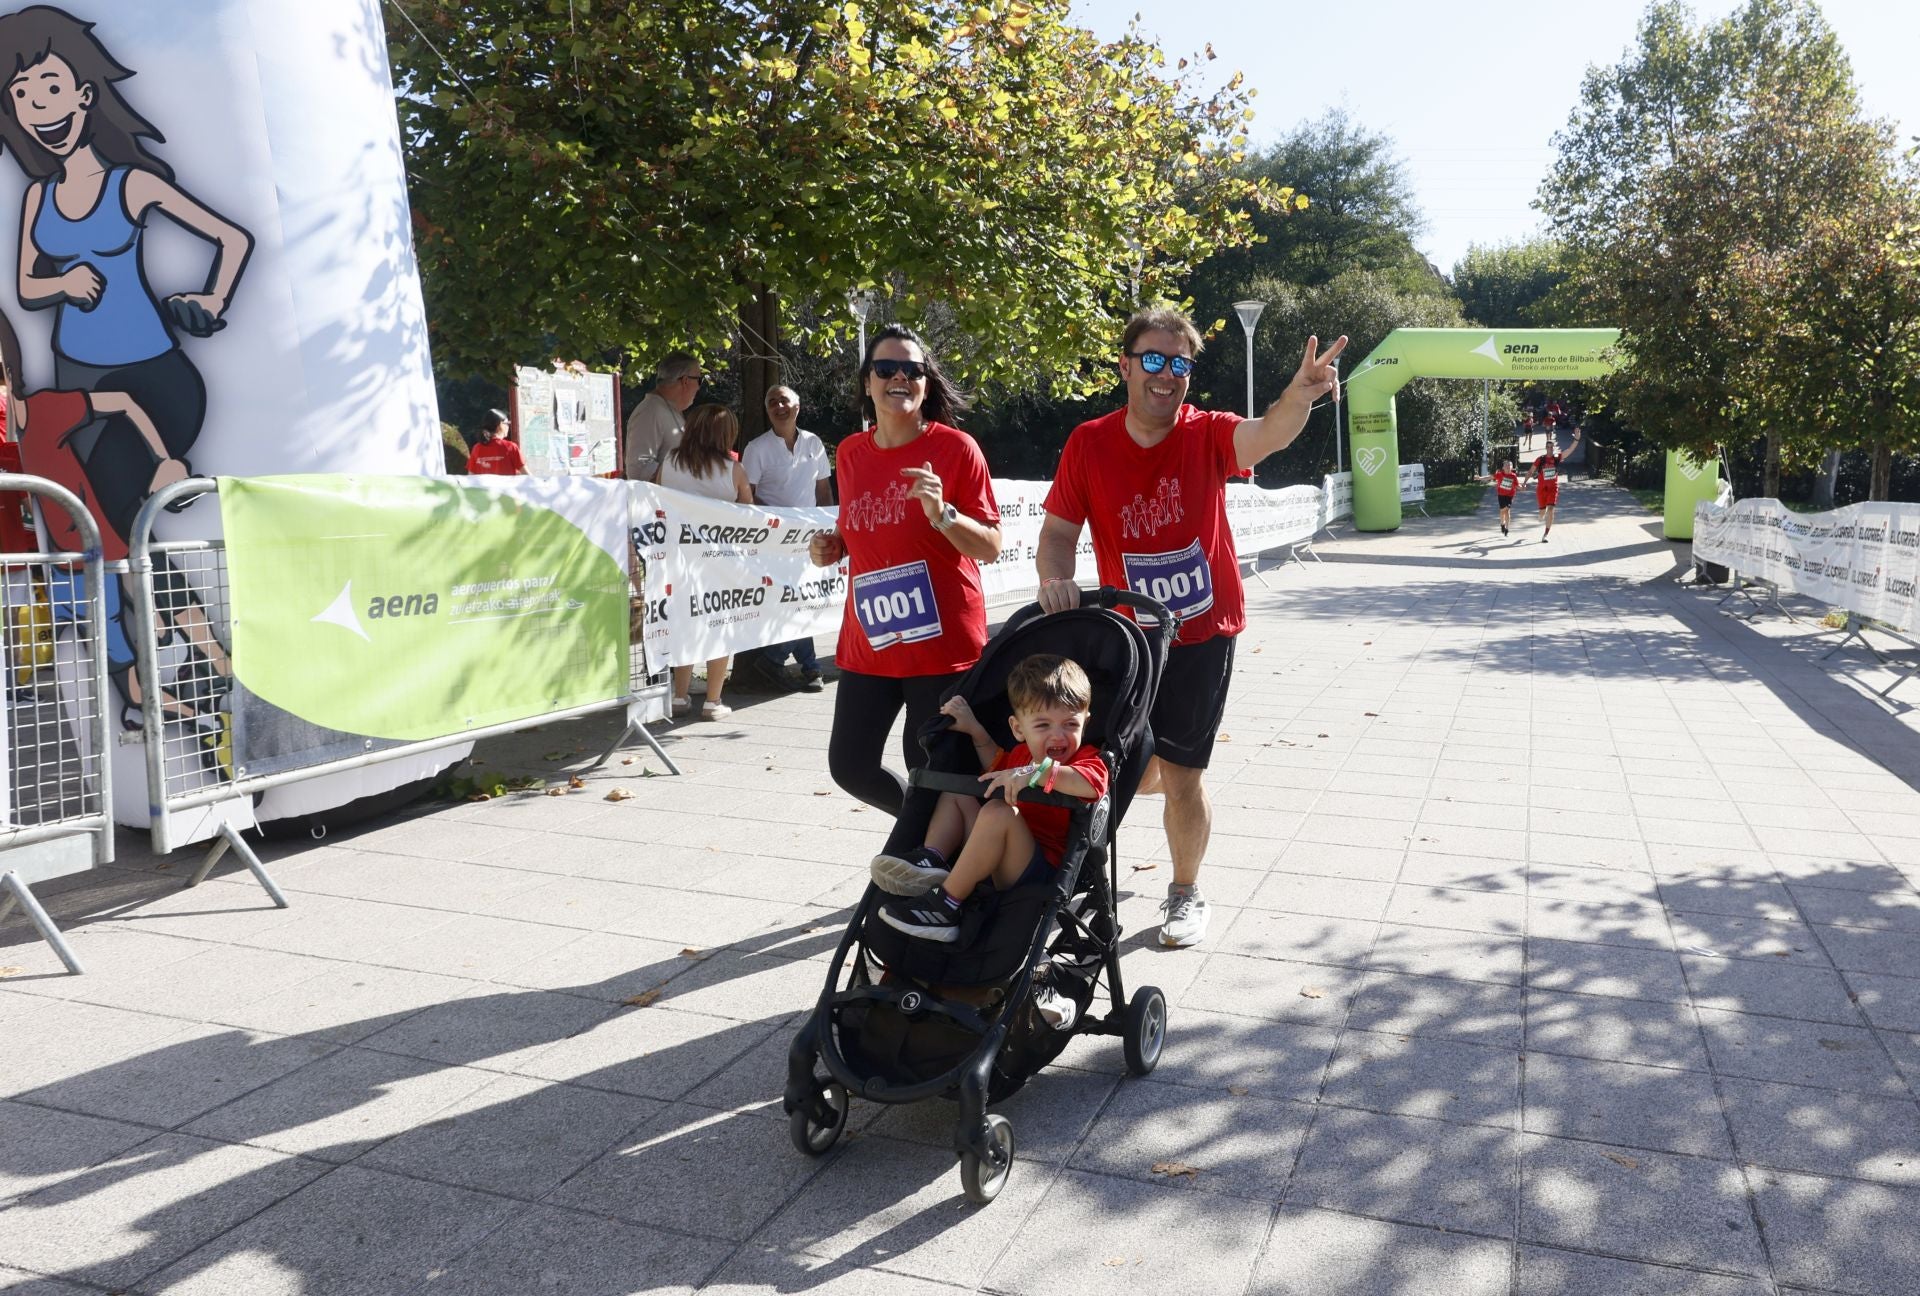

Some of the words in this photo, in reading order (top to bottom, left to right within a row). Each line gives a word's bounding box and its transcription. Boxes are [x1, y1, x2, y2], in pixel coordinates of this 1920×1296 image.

[1503, 343, 1539, 354] aena
[1511, 355, 1556, 364] Aeropuerto
[1557, 355, 1568, 363] de
[1569, 355, 1595, 363] Bilbao
[1374, 357, 1399, 365] aena
[699, 523, 770, 545] CORREO
[451, 577, 520, 597] aeropuertos
[523, 576, 549, 593] para
[1135, 565, 1205, 603] 1001
[367, 592, 440, 620] aena
[703, 586, 766, 614] CORREO
[798, 577, 845, 601] CORREO
[860, 586, 926, 626] 1001
